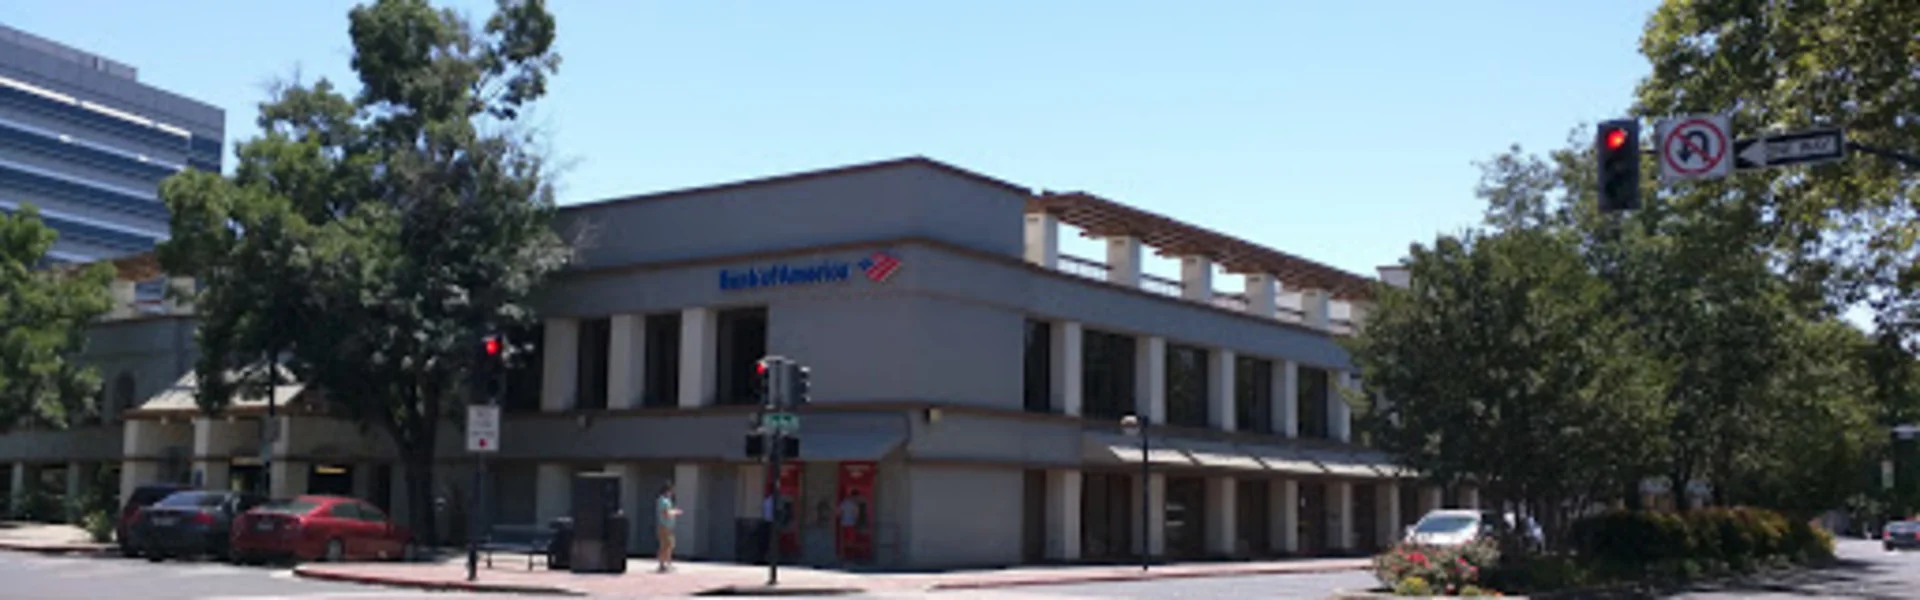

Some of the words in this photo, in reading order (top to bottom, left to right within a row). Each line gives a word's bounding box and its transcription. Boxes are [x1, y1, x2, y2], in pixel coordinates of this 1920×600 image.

[719, 266, 759, 290] Bank
[760, 264, 777, 286] of
[779, 260, 849, 284] America
